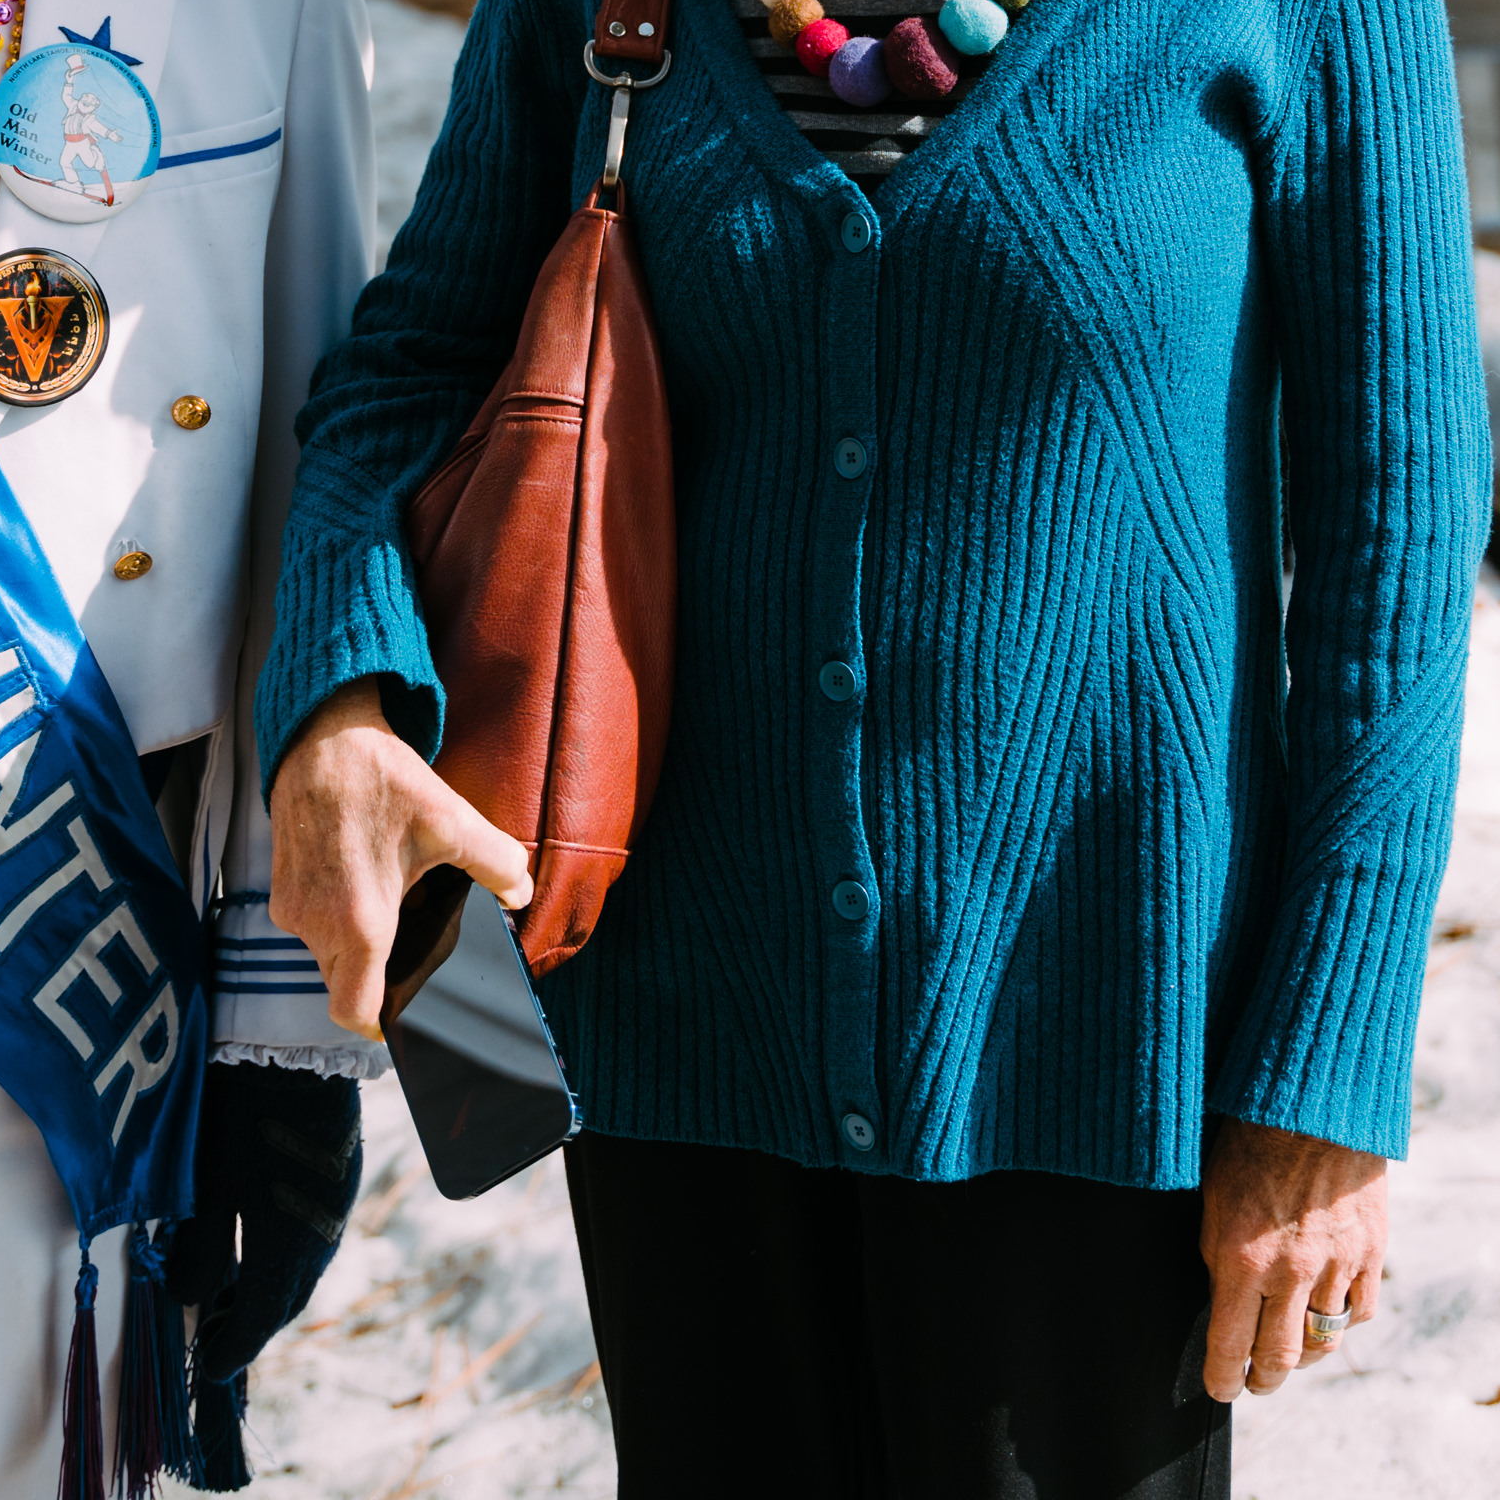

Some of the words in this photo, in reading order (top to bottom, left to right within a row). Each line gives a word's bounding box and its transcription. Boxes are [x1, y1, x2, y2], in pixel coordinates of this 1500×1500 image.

[9, 62, 29, 83] NORTH
[29, 53, 45, 66] LAKE
[105, 56, 137, 84] SNOWFEST
[137, 85, 152, 110] WINTER
[149, 112, 157, 148] CARNIVAL
[10, 104, 37, 123] Old
[3, 118, 38, 142] Man
[0, 132, 52, 165] Winter
[17, 262, 35, 272] 40th
[36, 262, 85, 293] ANNIVERSARY
